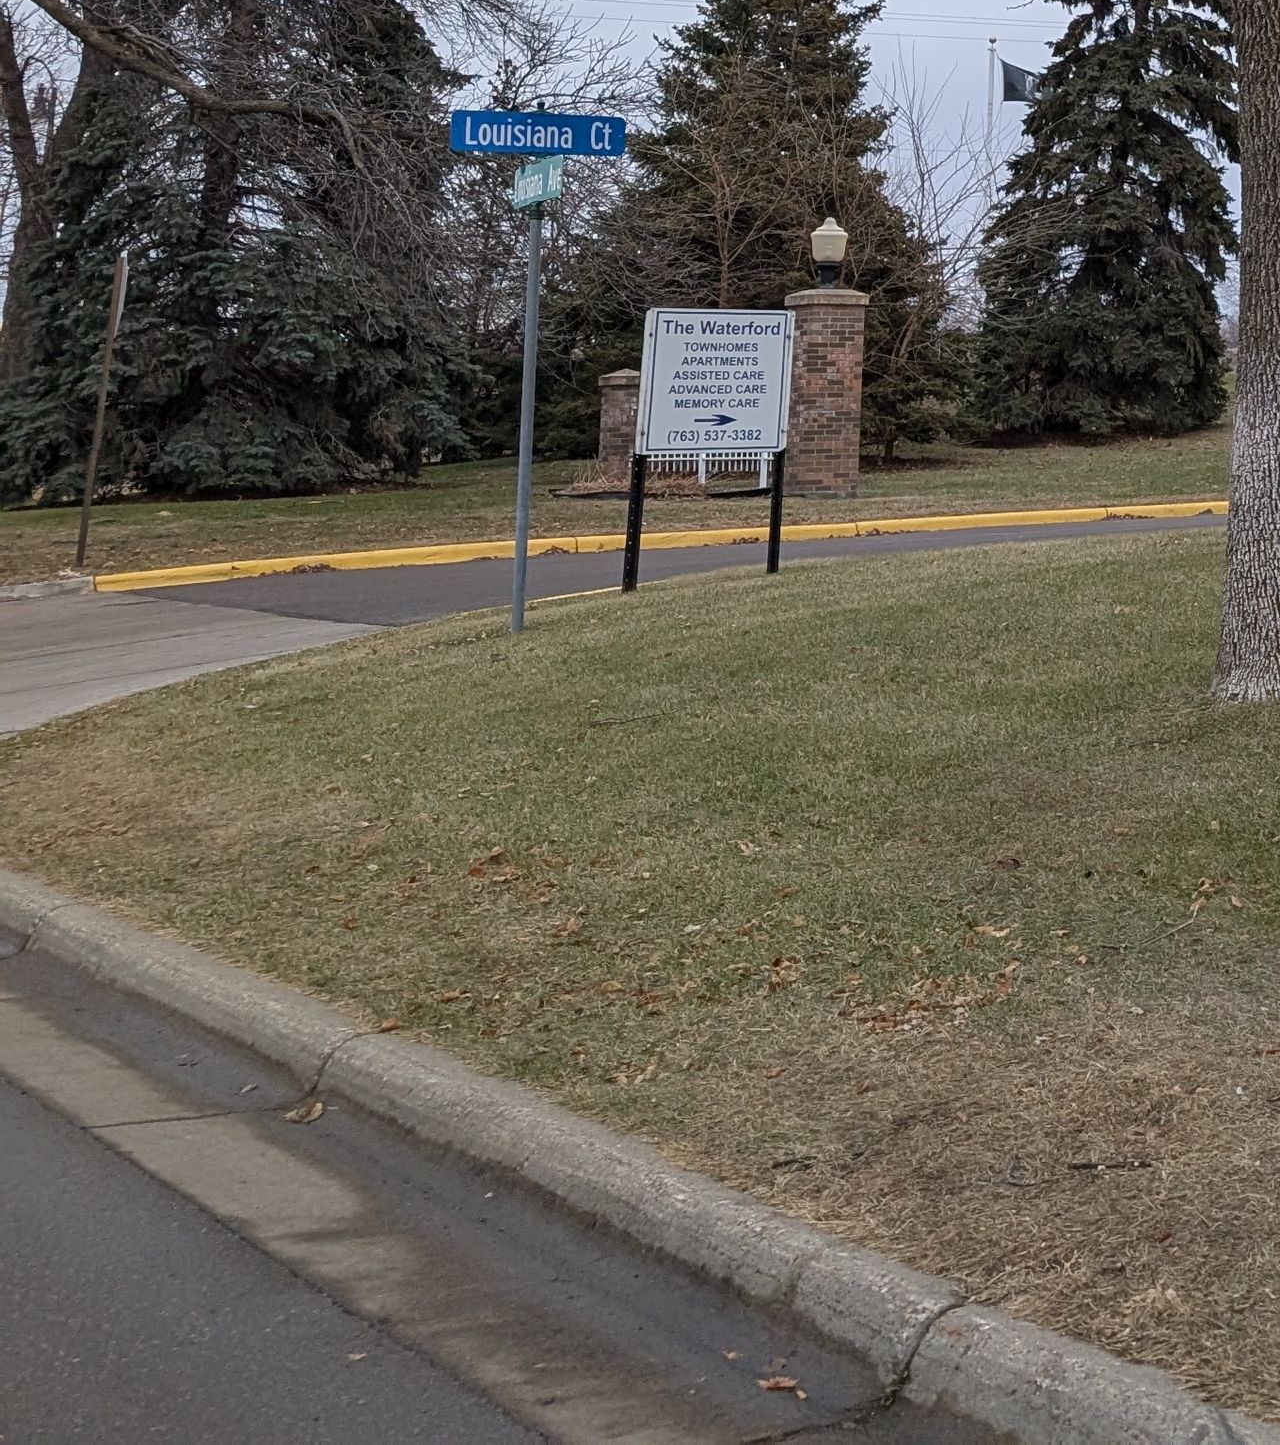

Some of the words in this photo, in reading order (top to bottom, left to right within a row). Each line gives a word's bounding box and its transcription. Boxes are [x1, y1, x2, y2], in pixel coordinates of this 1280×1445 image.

[465, 116, 573, 149] Louisiana
[590, 121, 613, 151] Ct
[547, 163, 561, 193] Ave
[663, 320, 695, 335] The
[700, 320, 781, 336] Waterford
[684, 342, 759, 352] TOWNHOMES
[681, 356, 759, 366] APARTMENTS
[672, 371, 730, 381] ASSISTED
[733, 370, 765, 381] CARE
[668, 385, 733, 395] ADVANCED
[735, 384, 767, 394] CARE
[674, 399, 726, 409] MEMORY
[728, 398, 760, 408] CARE
[667, 430, 700, 445] (763)
[703, 429, 762, 442] 537-3382
